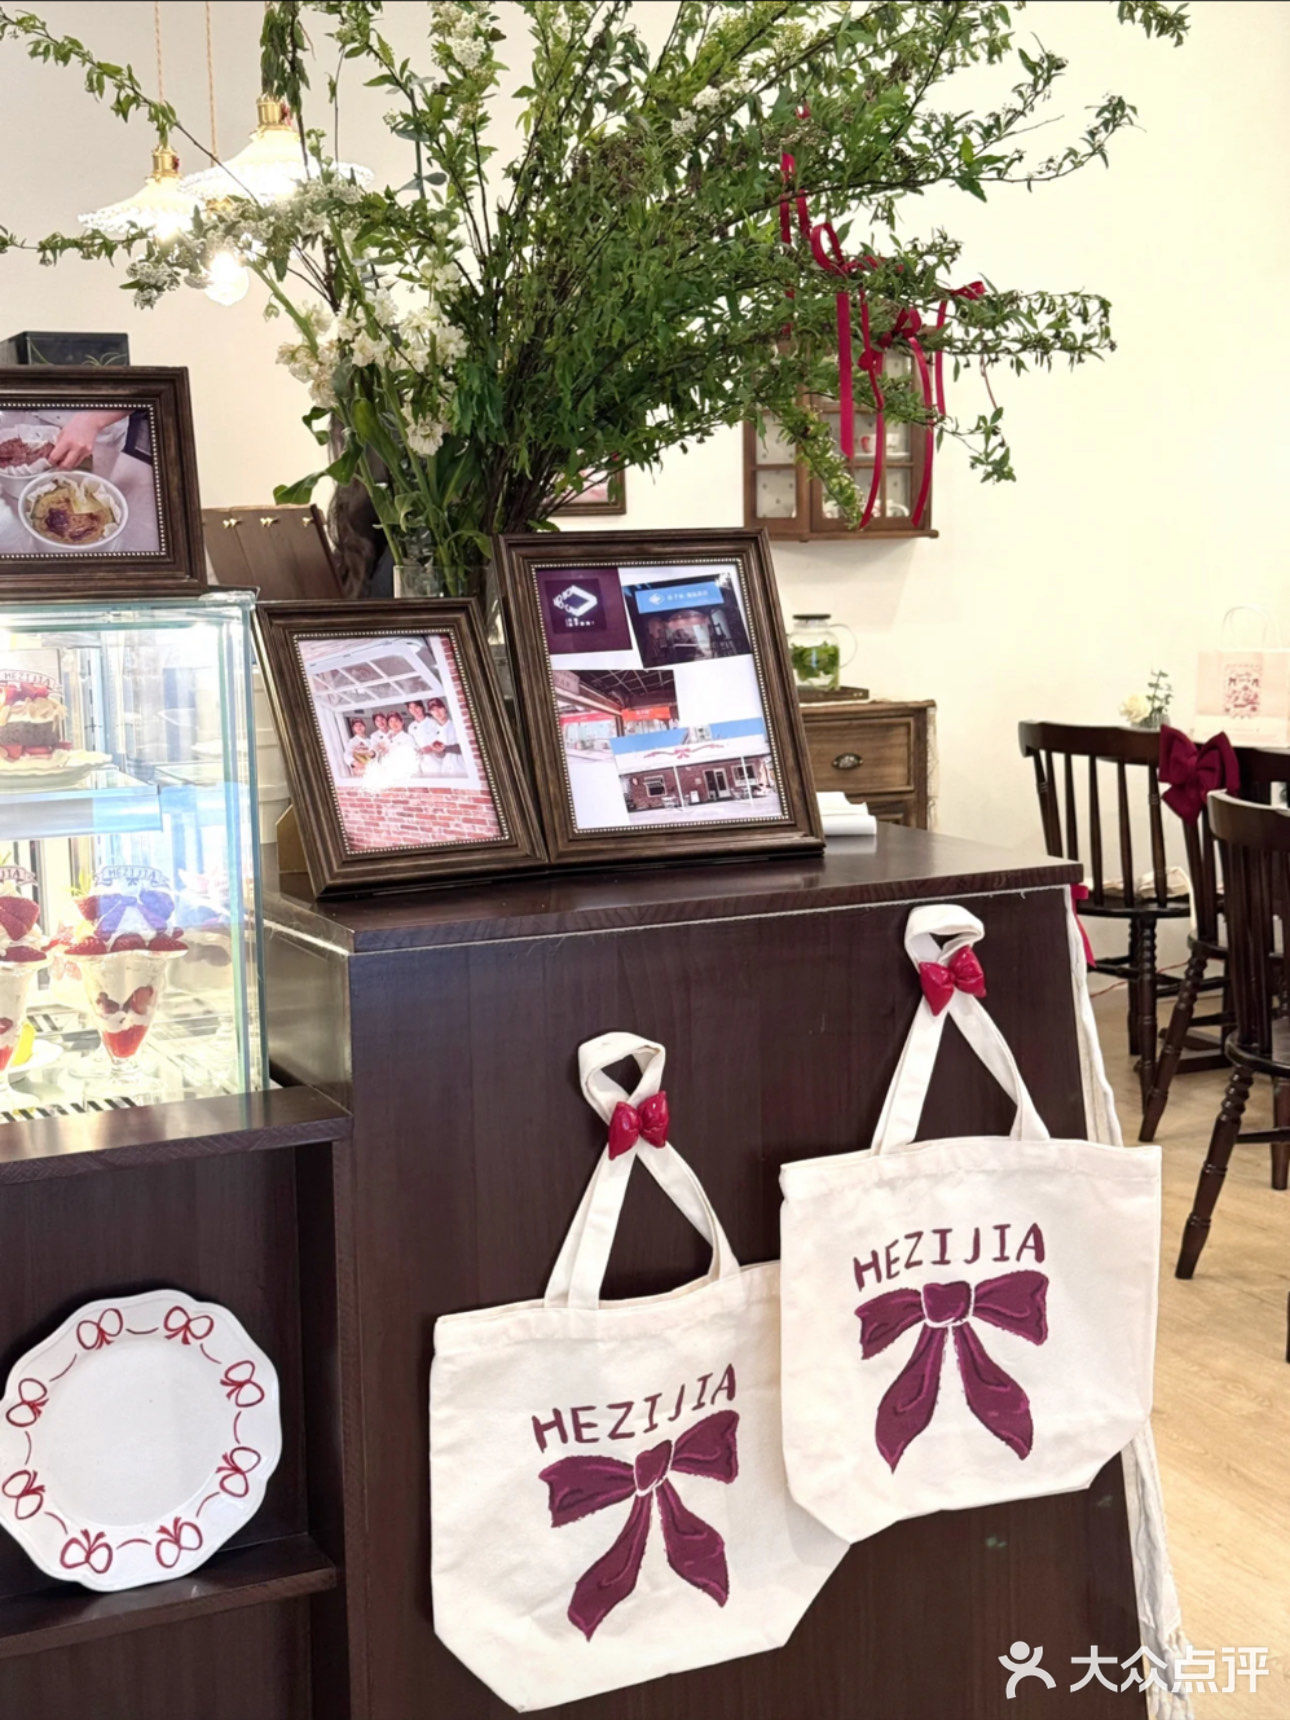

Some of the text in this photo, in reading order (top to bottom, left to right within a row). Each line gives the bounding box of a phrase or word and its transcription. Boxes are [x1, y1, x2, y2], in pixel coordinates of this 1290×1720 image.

[5, 672, 50, 686] HEZIJIA
[108, 867, 156, 880] HEZIJIA
[853, 1223, 1045, 1291] HEZIJIA
[532, 1363, 736, 1453] HEZIJIA
